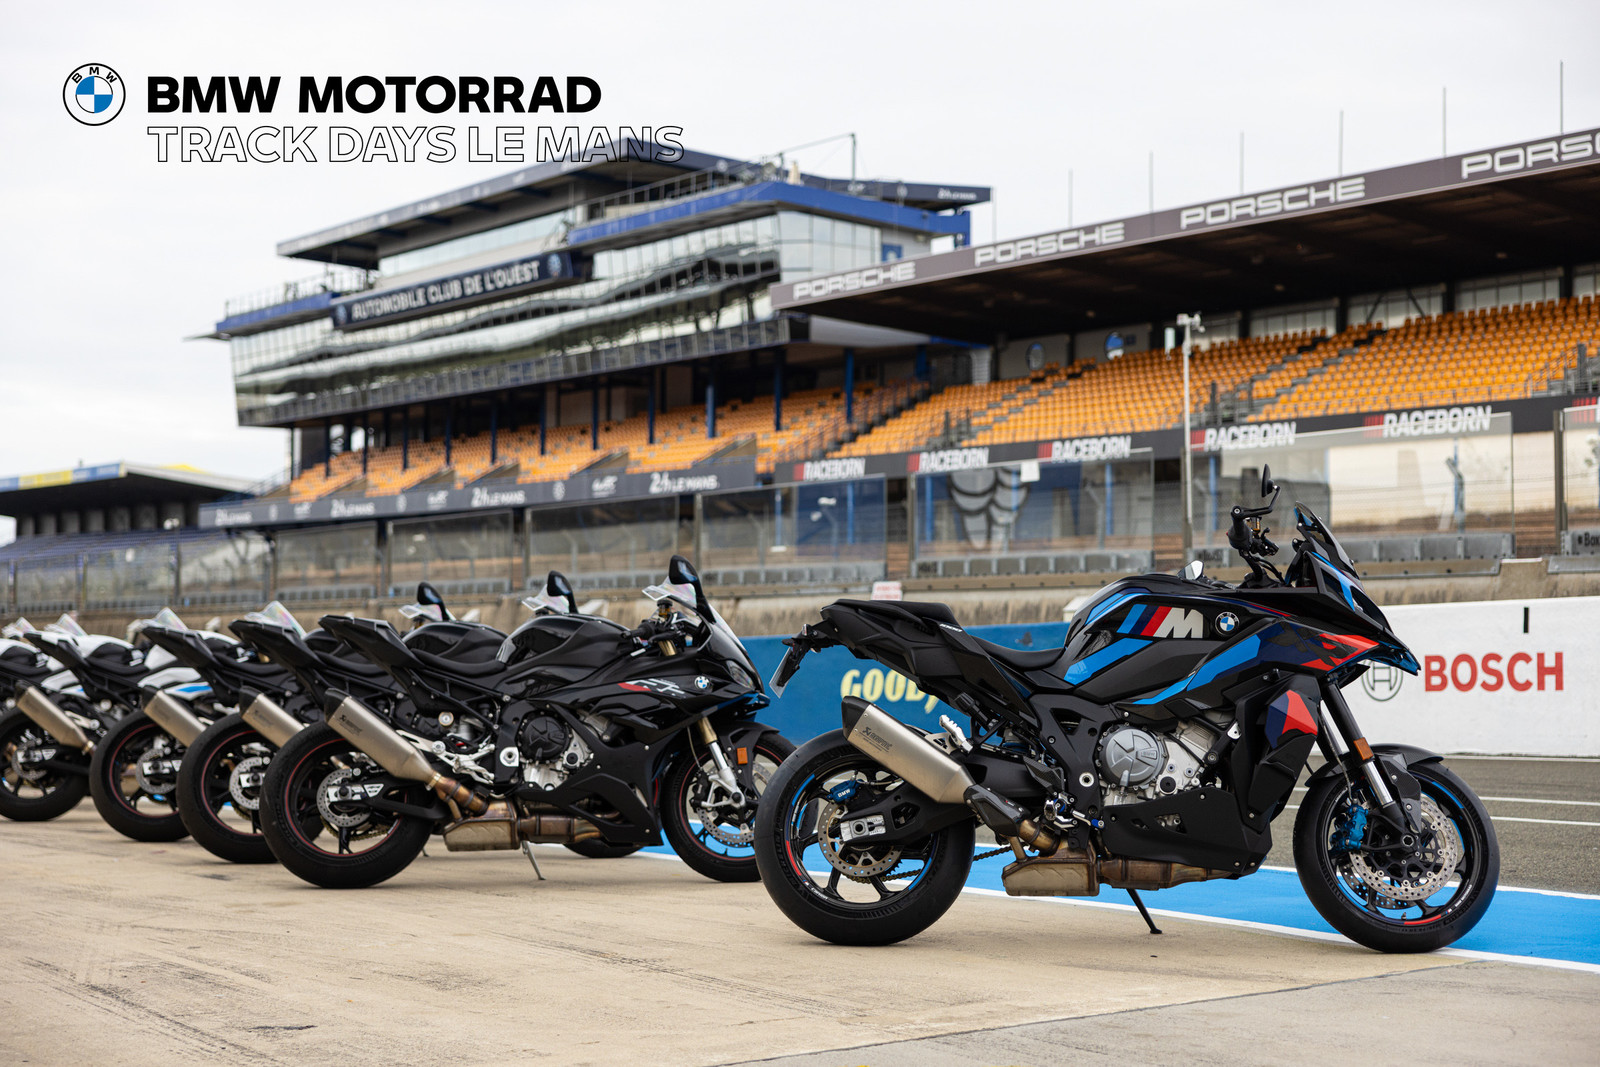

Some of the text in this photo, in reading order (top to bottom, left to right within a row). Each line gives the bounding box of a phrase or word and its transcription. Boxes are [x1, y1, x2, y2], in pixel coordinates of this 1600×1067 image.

[1461, 133, 1600, 179] PORS
[1180, 176, 1364, 230] PORSCHE
[975, 222, 1123, 267] PORSCHE
[352, 260, 540, 321] AUTOMOBILE CLUB DE L'OUEST
[793, 261, 915, 300] PORSCHE
[1203, 421, 1296, 450] RACEBORN
[1382, 405, 1491, 437] RACEBORN
[919, 447, 989, 474] RACEBORN
[1051, 436, 1131, 462] RACEBORN
[802, 457, 866, 481] RACEBORN
[1424, 652, 1564, 692] BOSCH
[838, 788, 850, 798] BMW
